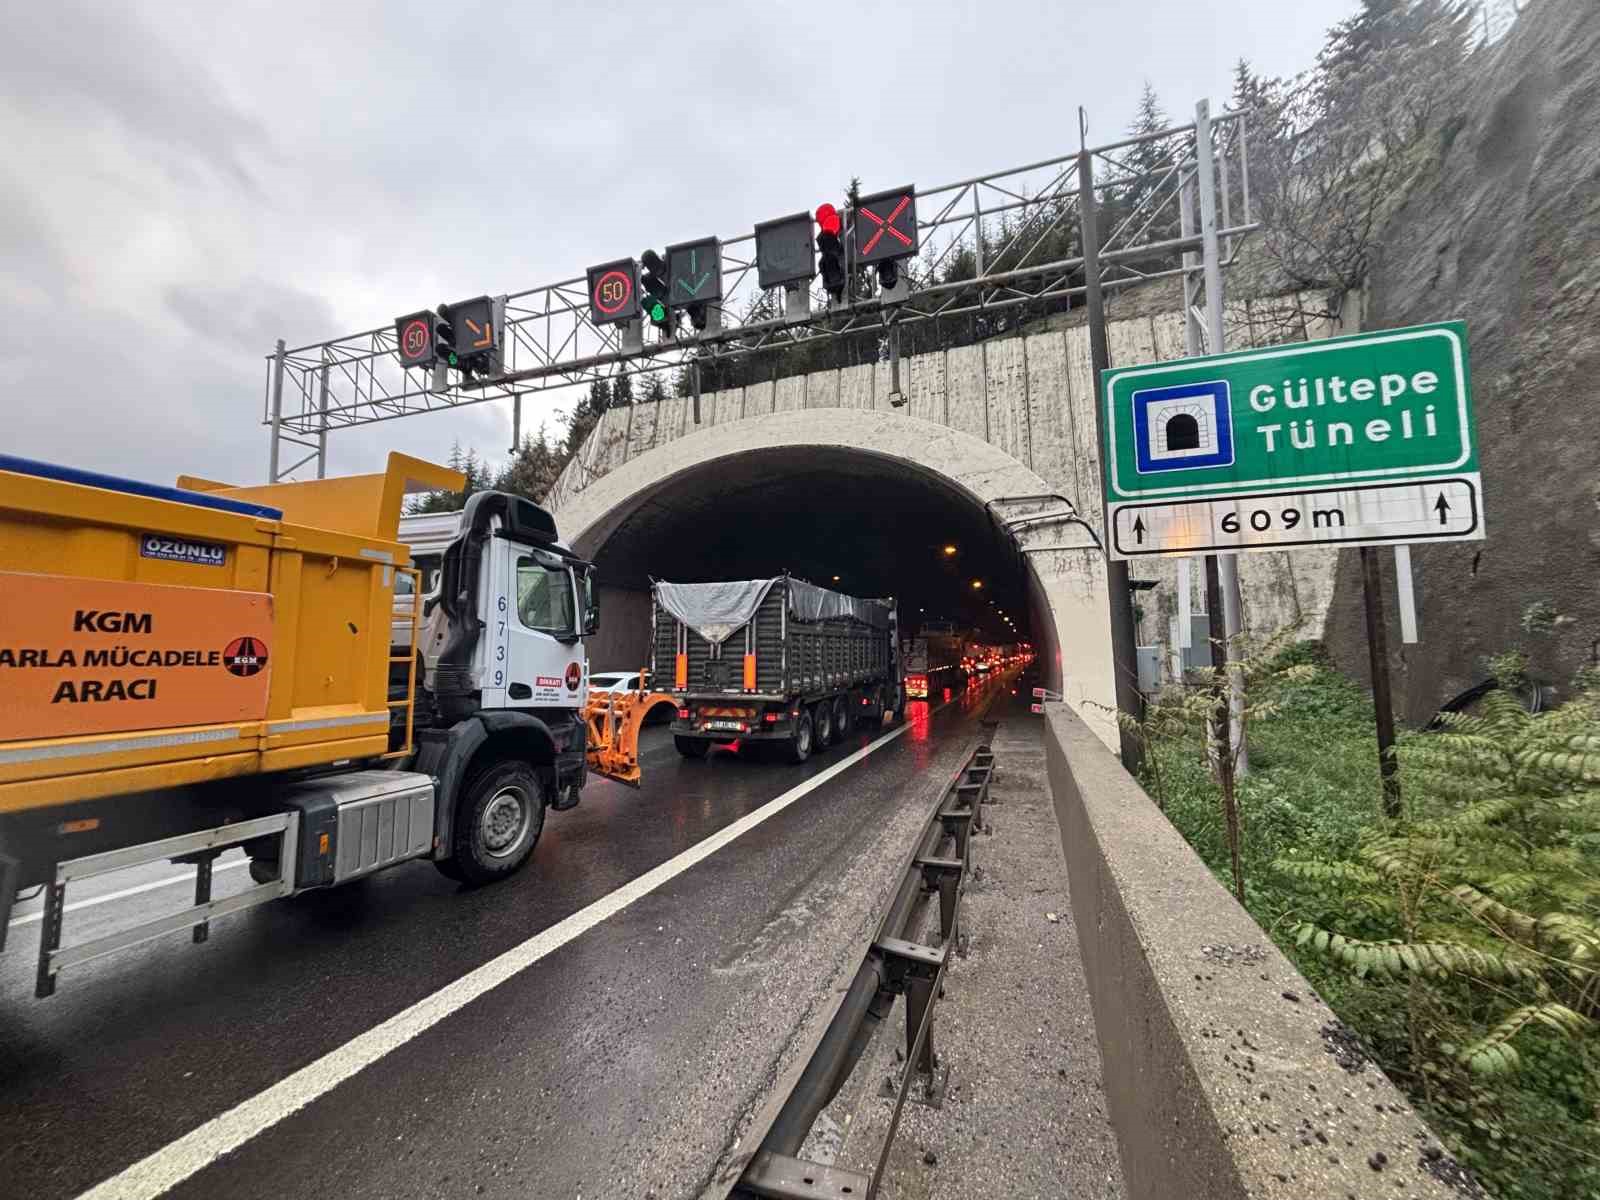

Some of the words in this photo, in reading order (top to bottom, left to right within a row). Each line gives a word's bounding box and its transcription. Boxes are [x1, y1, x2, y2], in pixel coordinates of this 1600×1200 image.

[603, 281, 623, 302] 50
[408, 329, 424, 349] 50
[1249, 370, 1439, 413] Gültepe
[1256, 404, 1438, 453] Tüneli
[1221, 508, 1301, 534] 609
[1312, 508, 1345, 528] m
[73, 610, 152, 634] KGM
[83, 646, 220, 667] MÜCADELE
[51, 679, 157, 704] ARACI
